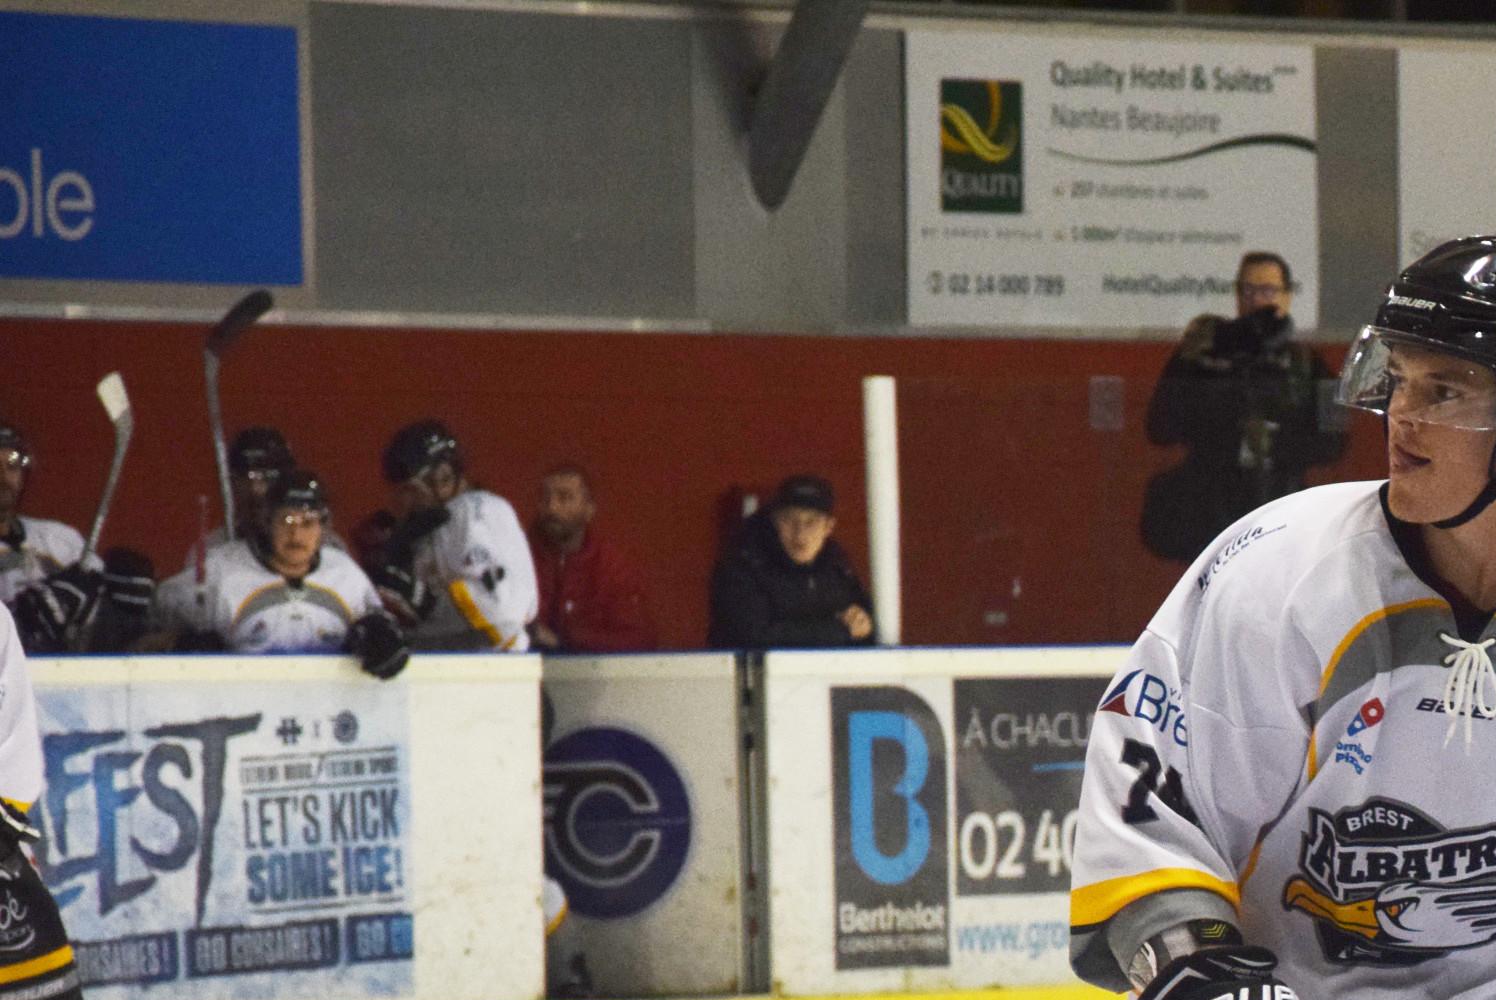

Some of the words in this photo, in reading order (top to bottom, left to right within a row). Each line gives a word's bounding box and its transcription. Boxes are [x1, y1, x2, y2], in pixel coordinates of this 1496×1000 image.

[1050, 60, 1124, 93] Quality
[1130, 64, 1186, 91] Hotel
[1191, 65, 1208, 92] &
[243, 792, 321, 851] LET'S
[330, 787, 399, 842] KICK
[1346, 806, 1414, 833] BREST
[960, 810, 1026, 880] 02
[247, 853, 337, 902] SOME
